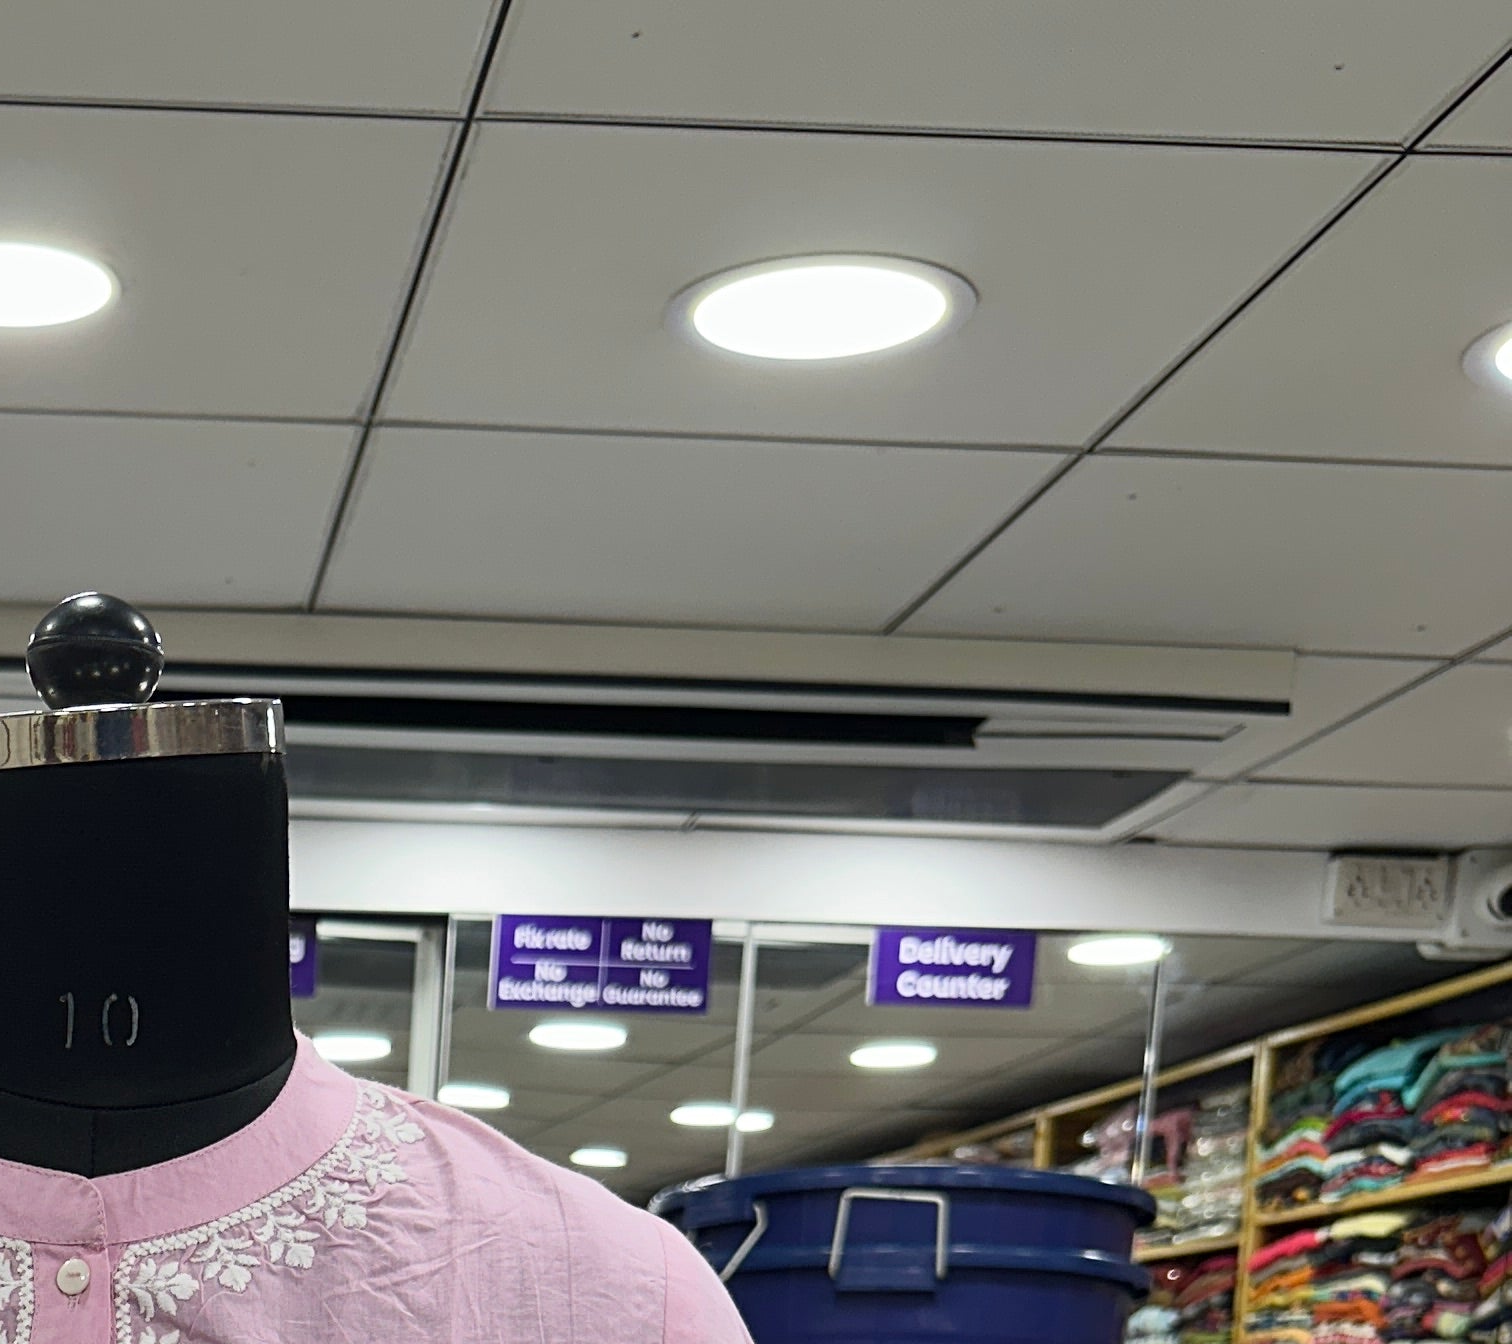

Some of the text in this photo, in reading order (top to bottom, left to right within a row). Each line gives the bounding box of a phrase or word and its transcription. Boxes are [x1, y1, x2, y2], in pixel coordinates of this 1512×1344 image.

[620, 938, 692, 963] Return
[899, 936, 1014, 973] Delivery
[498, 976, 598, 1007] Exchange
[602, 980, 704, 1007] Guarantee
[896, 970, 1011, 1000] Counter
[59, 991, 139, 1049] 10
